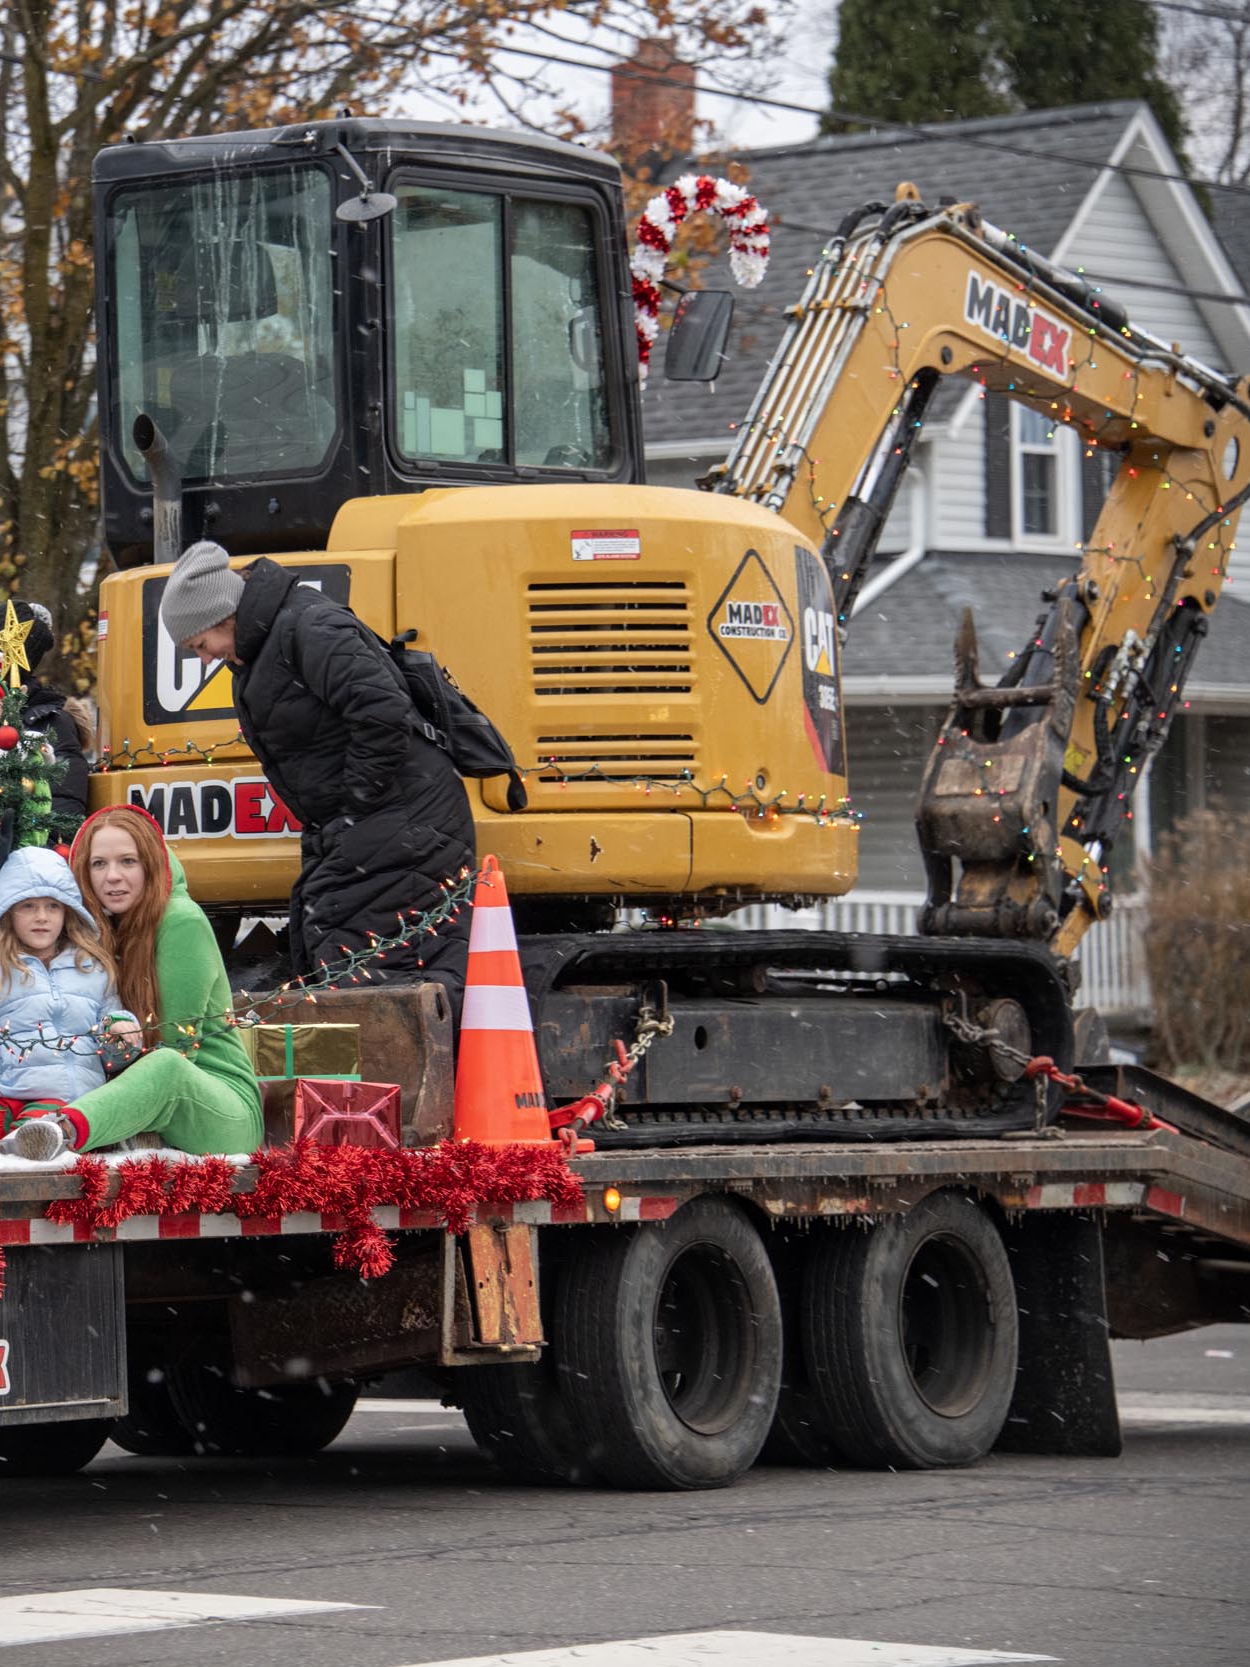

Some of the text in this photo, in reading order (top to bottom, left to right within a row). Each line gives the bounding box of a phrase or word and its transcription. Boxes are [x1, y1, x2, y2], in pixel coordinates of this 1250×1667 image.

[967, 276, 1069, 376] MADEX
[721, 625, 775, 638] CONSTRUCTION
[728, 603, 779, 627] MADEX
[804, 606, 835, 678] CAT
